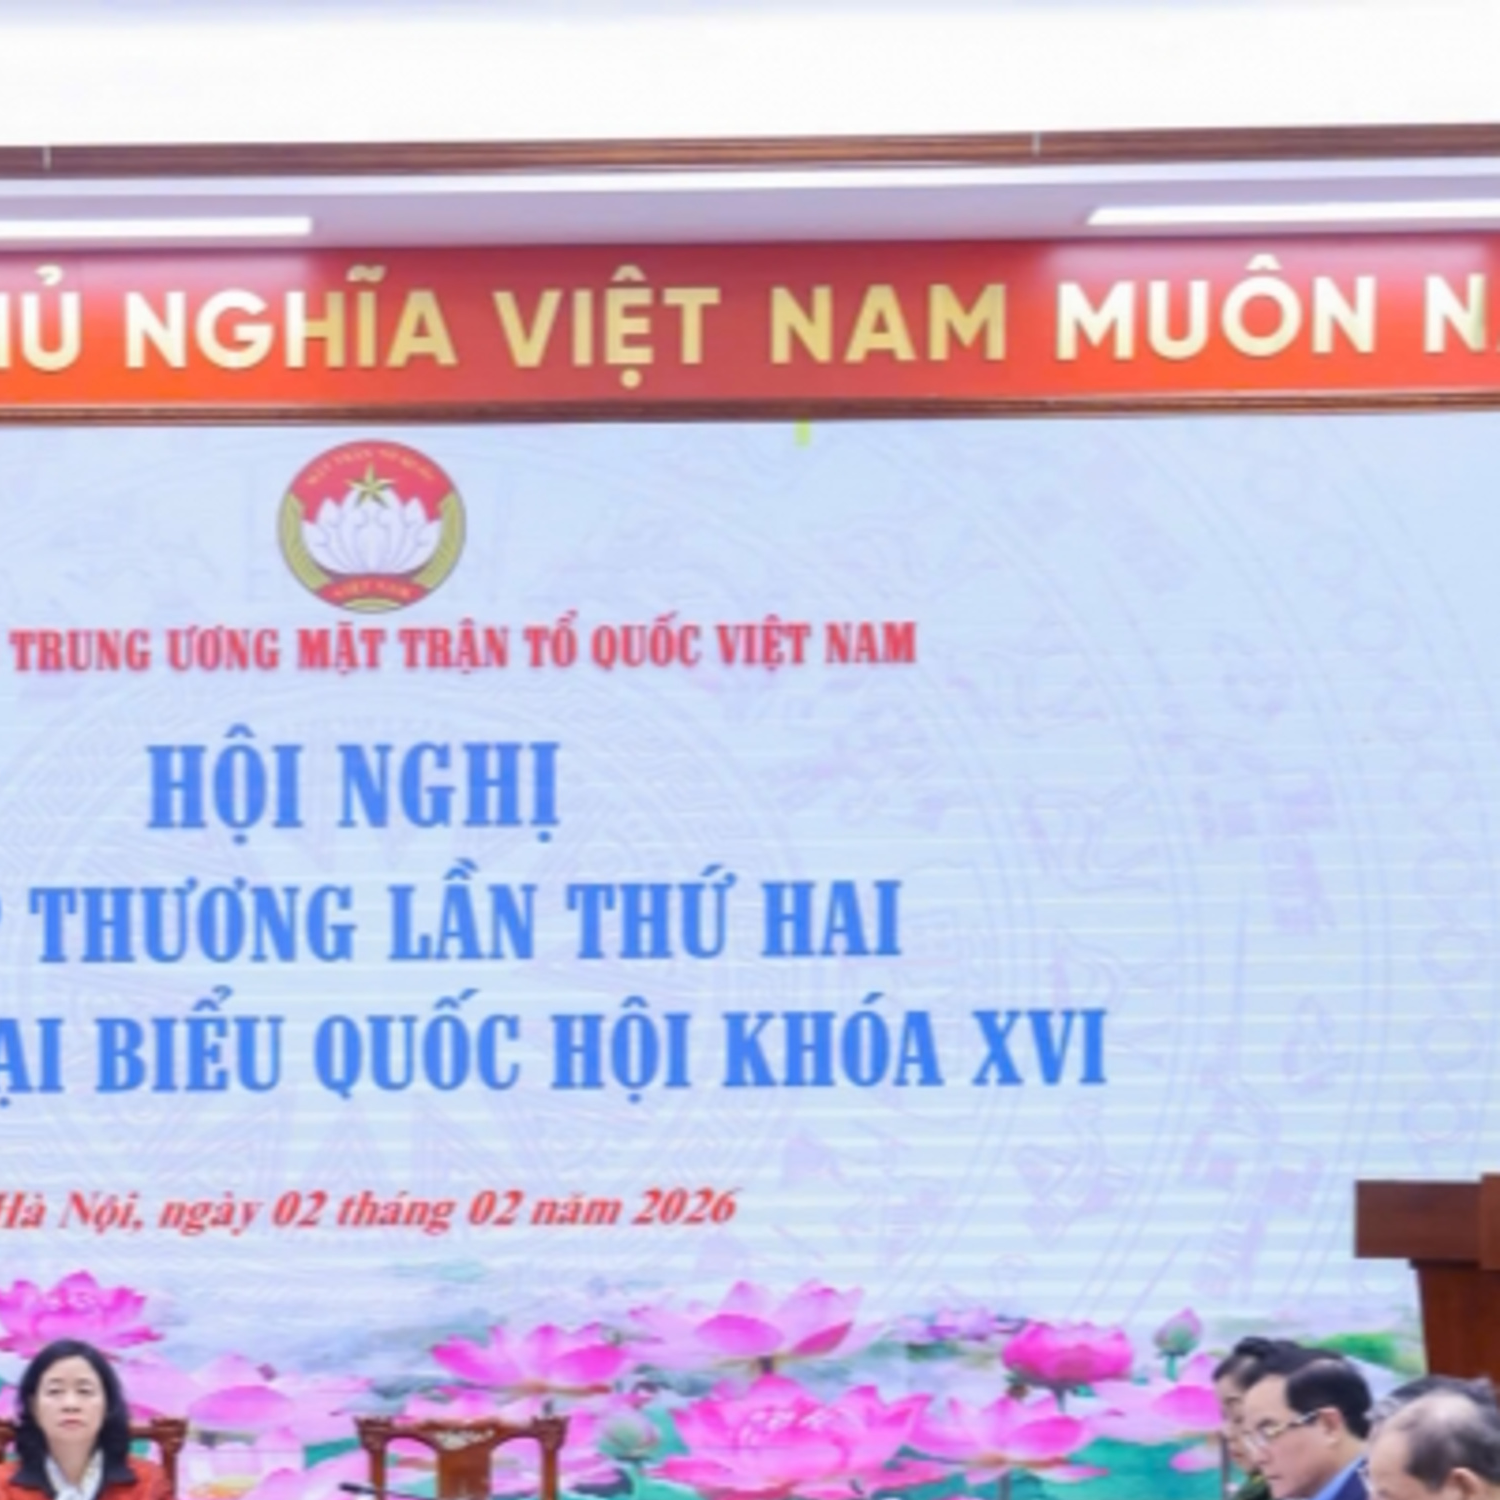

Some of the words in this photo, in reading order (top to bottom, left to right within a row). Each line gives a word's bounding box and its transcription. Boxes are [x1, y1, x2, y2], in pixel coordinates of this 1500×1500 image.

[125, 264, 459, 371] NGHĨA
[493, 264, 721, 388] VIỆT
[769, 283, 1006, 364] NAM
[1055, 253, 1377, 360] MUÔN
[8, 628, 152, 672] TRUNG
[166, 624, 281, 671] ƯƠNG
[296, 621, 386, 674] MẶT
[398, 618, 510, 673] TRẬN
[589, 610, 702, 670] QUỐC
[715, 614, 812, 671] VIỆT
[824, 620, 918, 665] NAM
[146, 723, 305, 845] HỘI
[337, 740, 560, 843] NGHỊ
[27, 875, 358, 964] THƯƠNG
[388, 857, 538, 962] LẦN
[565, 863, 738, 960] THỨ
[760, 879, 904, 959] HAI
[94, 984, 284, 1096] BIỂU
[312, 987, 521, 1099] QUỐC
[550, 994, 692, 1103] HỘI
[721, 990, 946, 1089] KHÓA
[970, 1006, 1109, 1087] XVI
[58, 1190, 145, 1234] Nội,
[156, 1192, 262, 1236] ngày
[270, 1189, 329, 1229] 02
[335, 1190, 458, 1235] tháng
[466, 1188, 526, 1228] 02
[530, 1194, 624, 1226] năm
[631, 1186, 744, 1226] 2026
